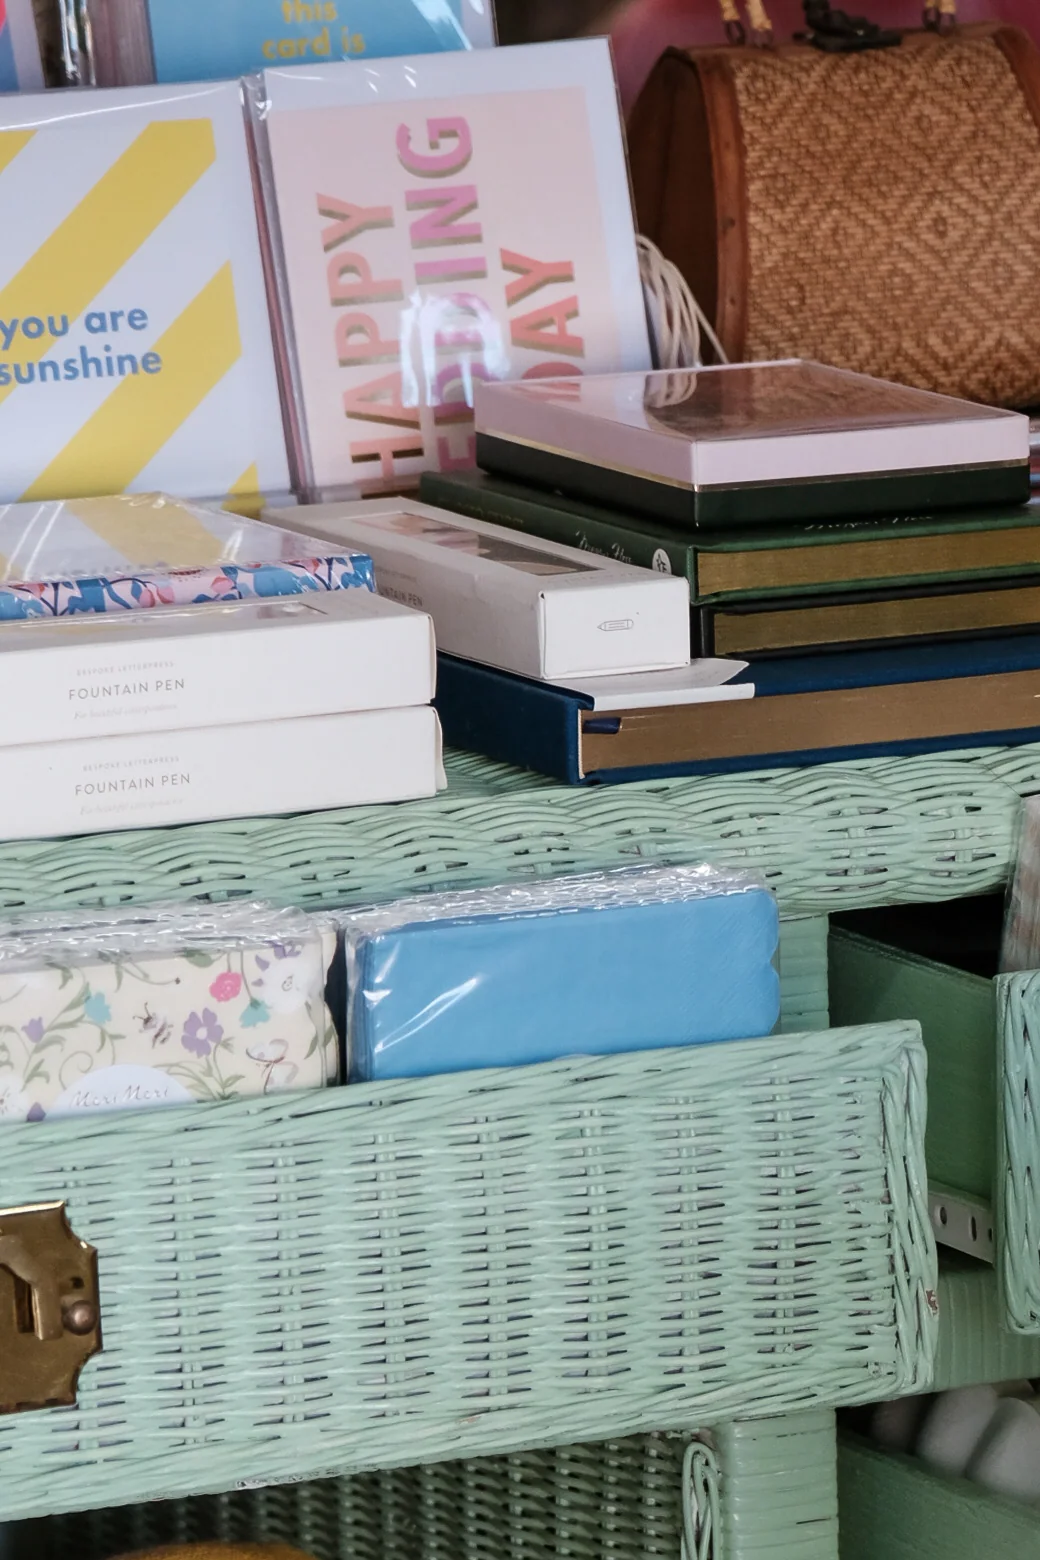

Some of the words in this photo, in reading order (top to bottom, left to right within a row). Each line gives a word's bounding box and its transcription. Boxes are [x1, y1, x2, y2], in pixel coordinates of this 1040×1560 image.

[262, 26, 330, 59] card
[341, 25, 366, 54] is
[396, 116, 490, 472] EDDING
[0, 314, 70, 351] you
[84, 308, 149, 334] are
[316, 192, 424, 499] HAPPY
[0, 344, 163, 386] sunshine
[68, 682, 149, 701] FOUNTAIN
[155, 678, 185, 692] PEN
[75, 777, 155, 796] FOUNTAIN
[161, 773, 191, 786] PEN
[71, 1090, 117, 1108] Meri
[122, 1083, 168, 1101] Meri
